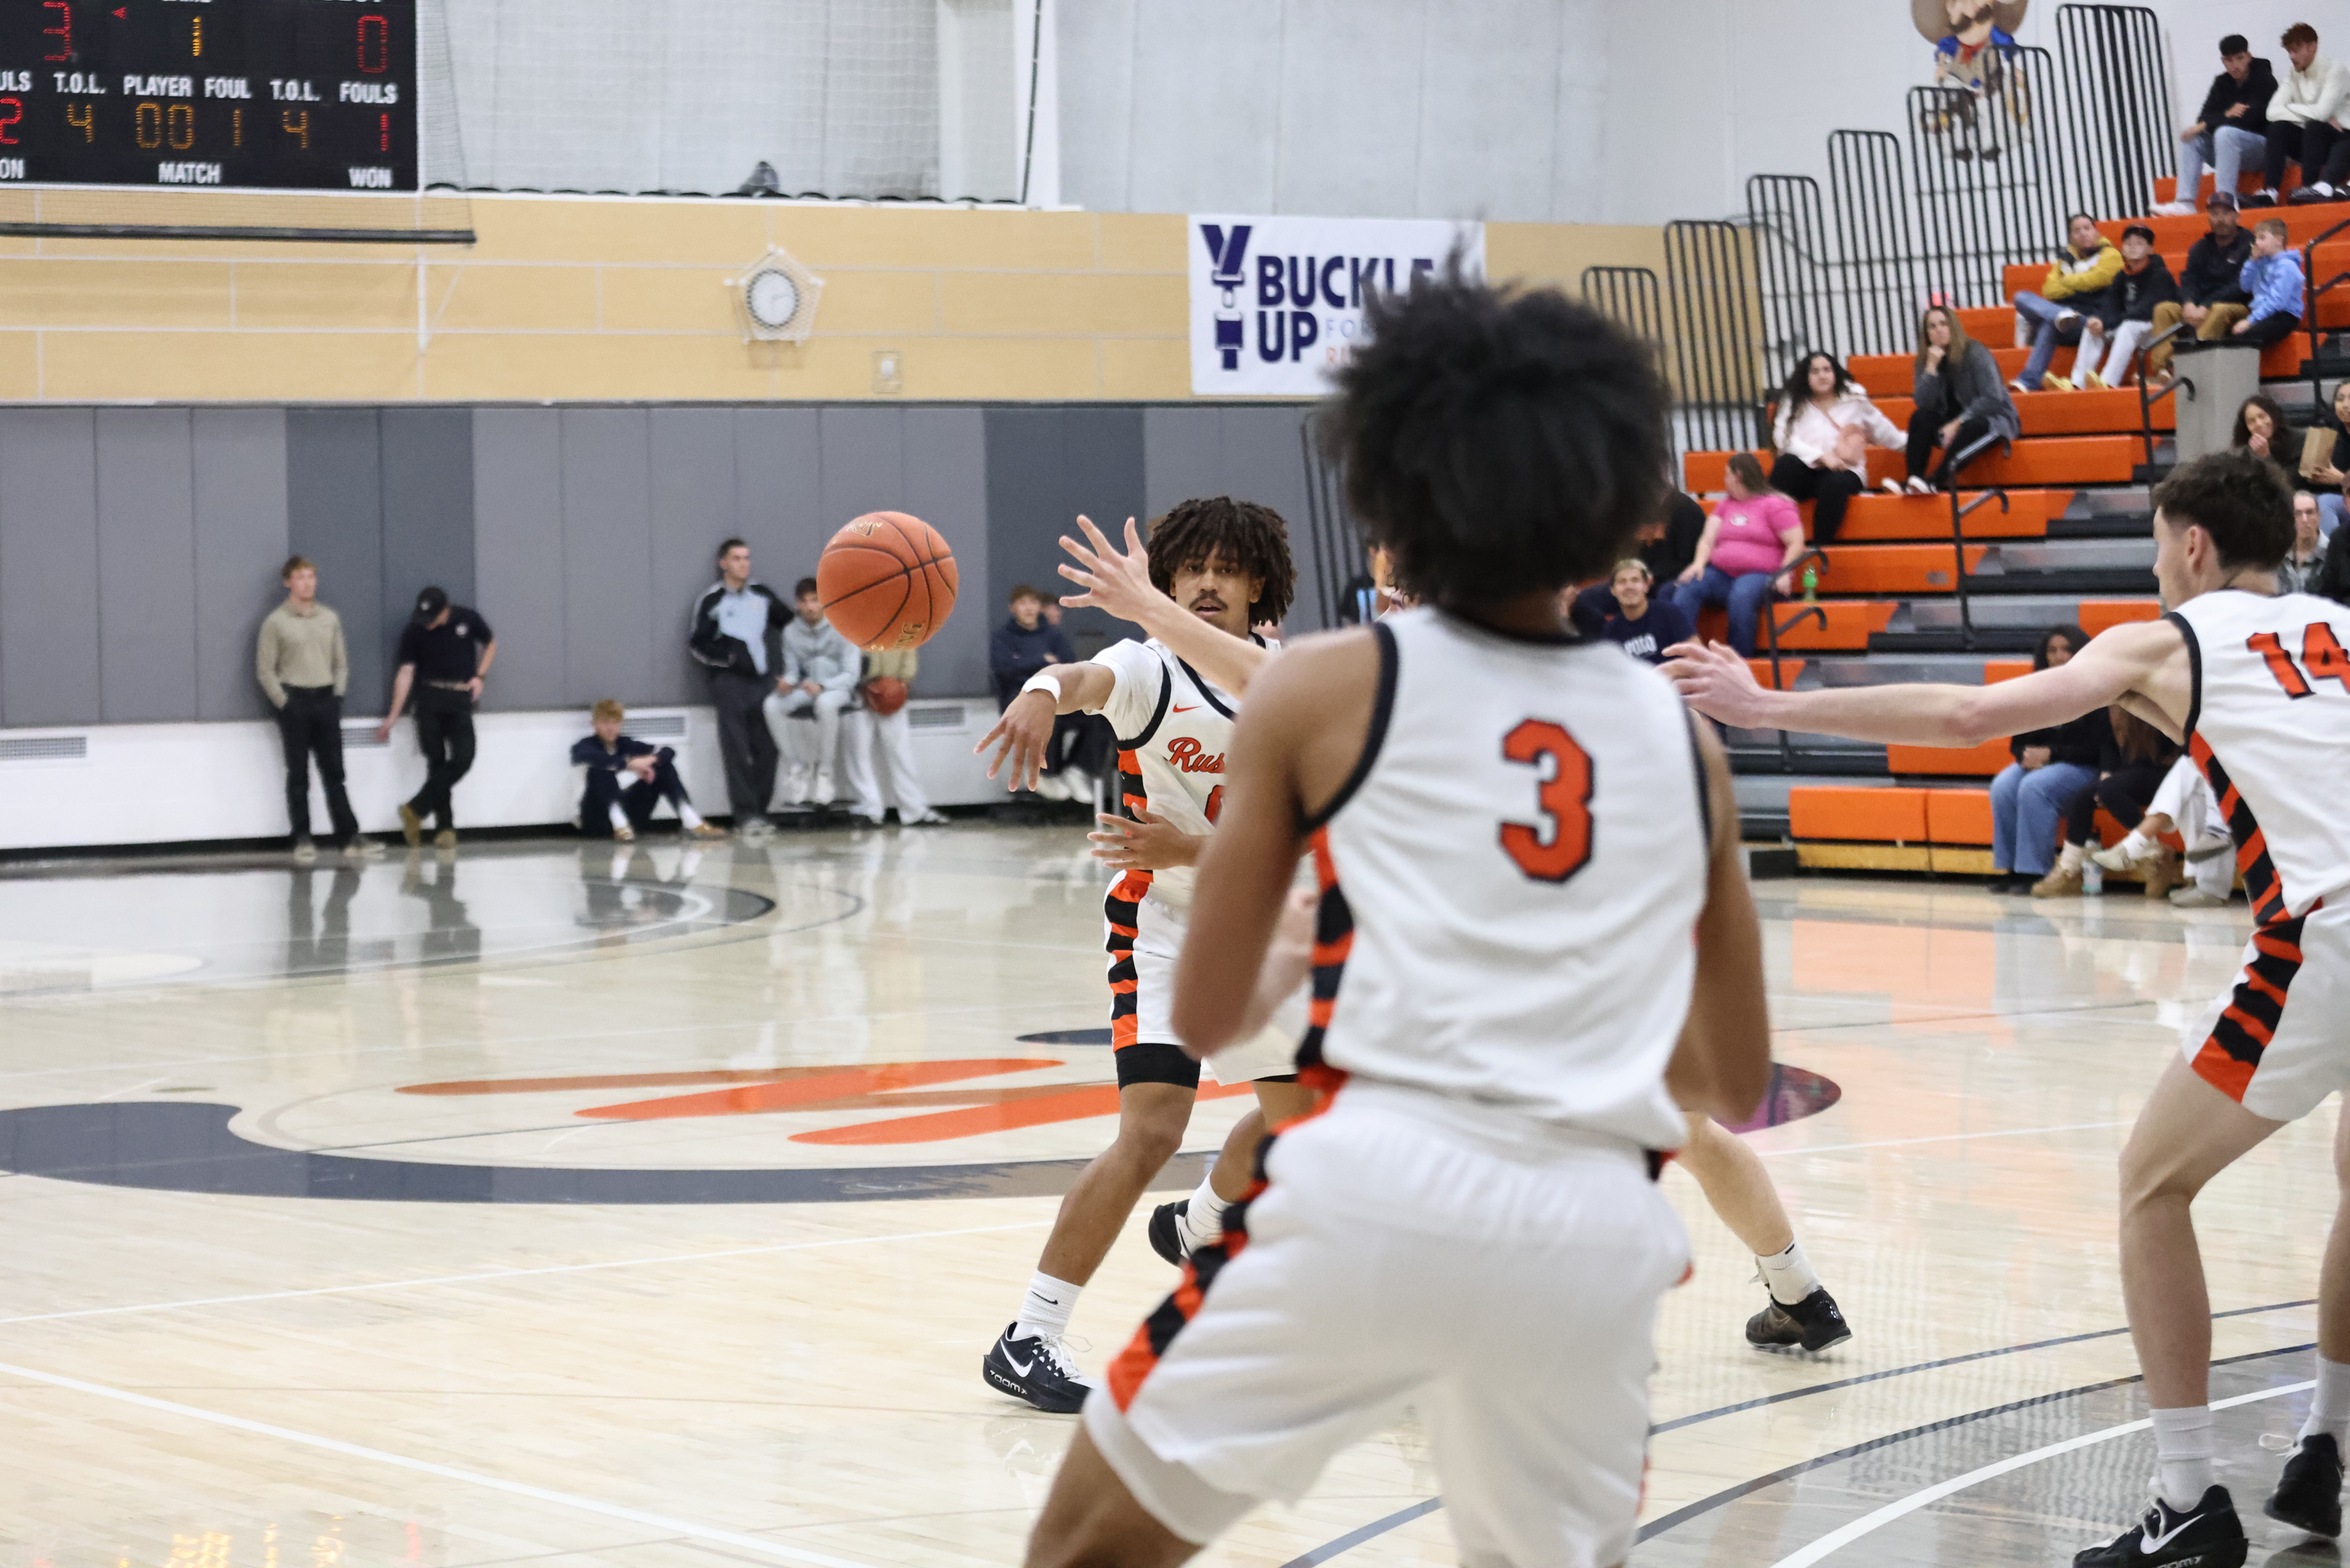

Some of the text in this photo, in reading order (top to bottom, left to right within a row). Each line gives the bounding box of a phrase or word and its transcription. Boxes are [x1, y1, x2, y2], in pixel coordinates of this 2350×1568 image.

[43, 1, 71, 62] 3
[191, 16, 202, 57] 1
[357, 15, 389, 74] 0
[53, 72, 106, 95] T.O.L.
[123, 74, 252, 99] PLAYER FOUL
[270, 79, 320, 102] T.O.L.
[339, 82, 398, 104] FOULS
[0, 97, 23, 145] 2
[67, 103, 93, 145] 4
[136, 102, 194, 150] 00
[233, 108, 242, 147] 1
[282, 111, 308, 149] 4
[380, 113, 390, 152] 1
[158, 162, 221, 184] MATCH
[349, 167, 393, 189] WON
[1257, 310, 1318, 363] UP
[2245, 621, 2350, 701] 14
[1499, 717, 1596, 884] 3
